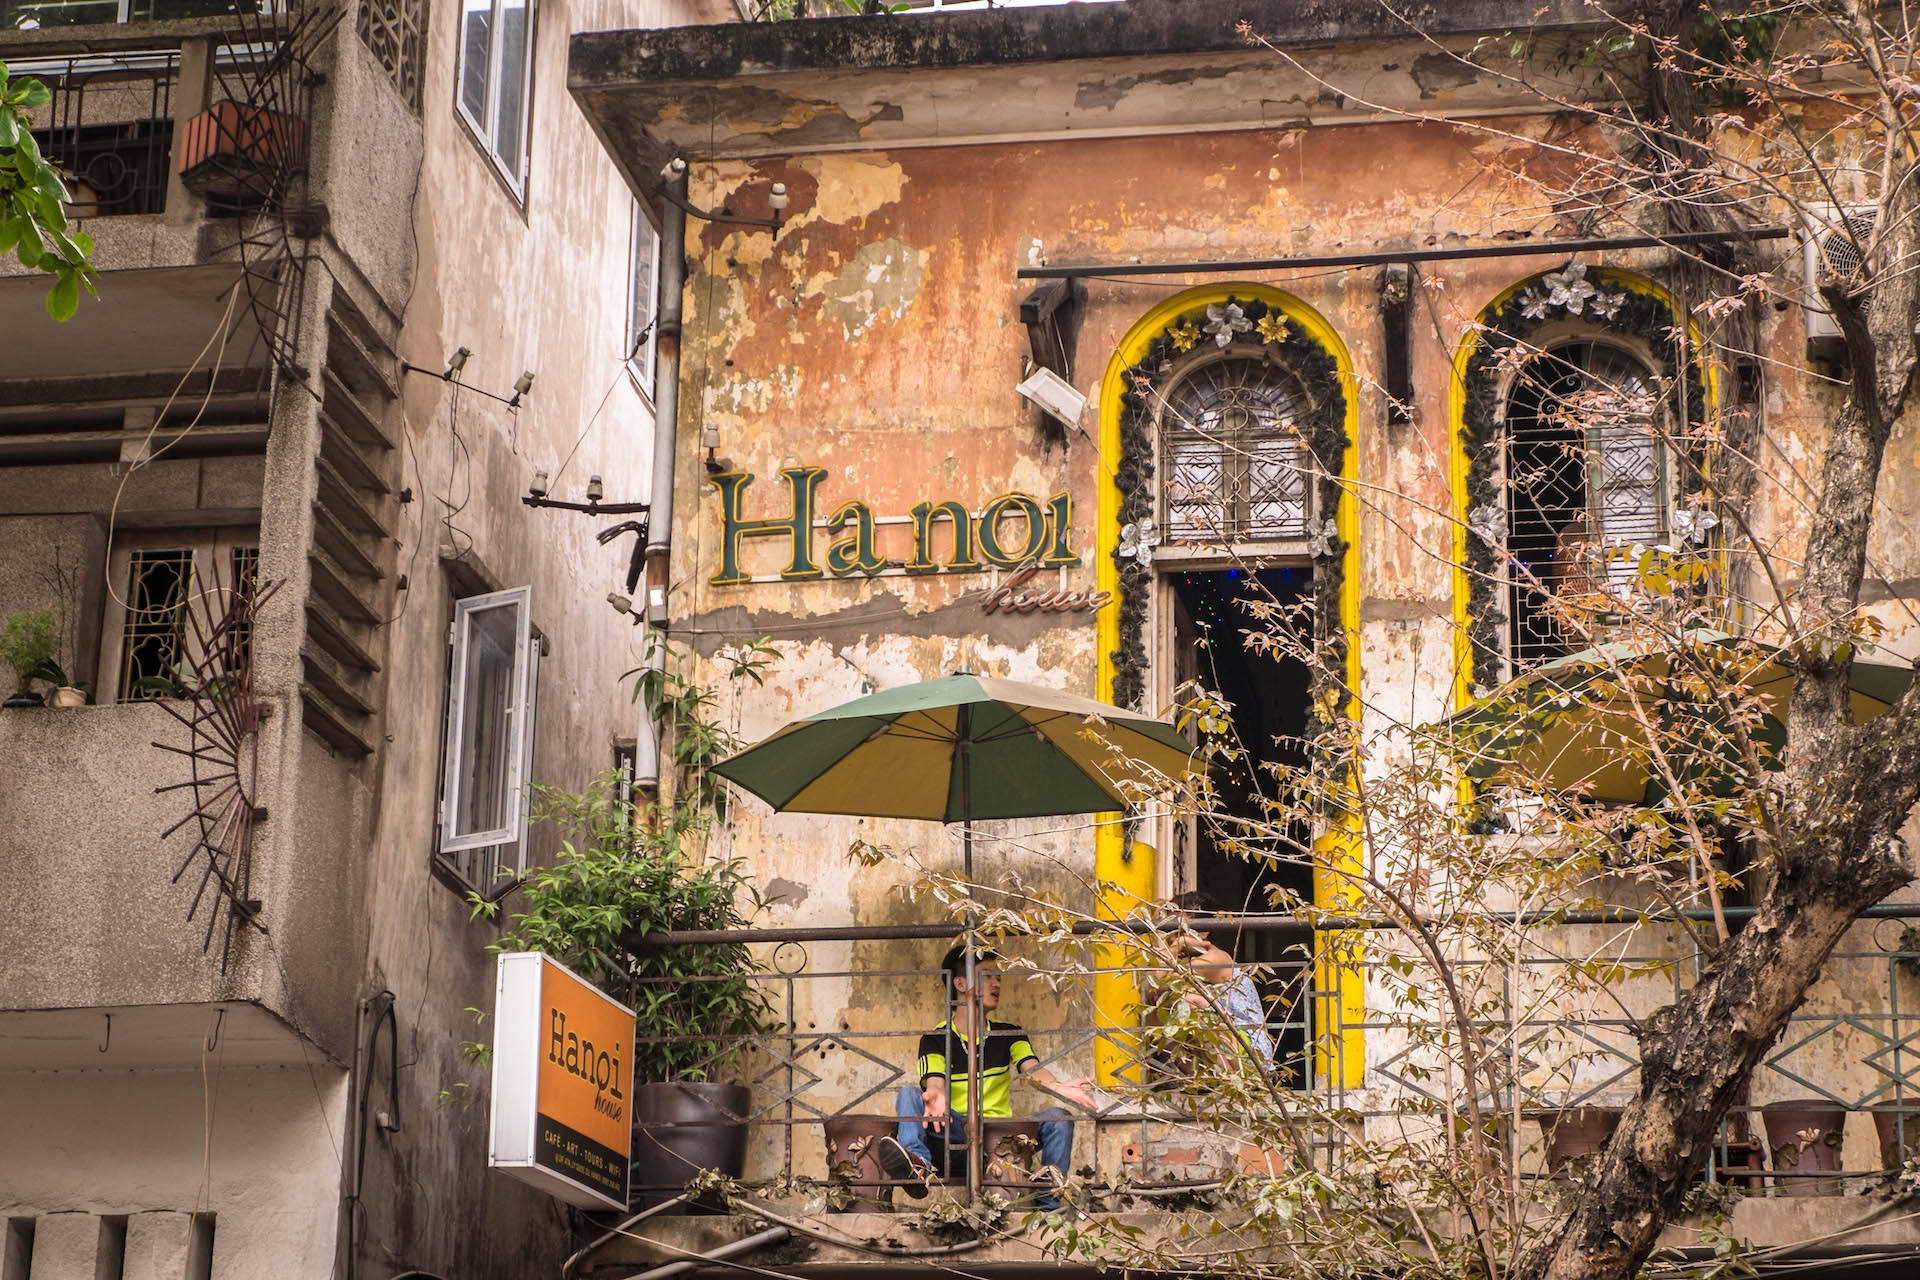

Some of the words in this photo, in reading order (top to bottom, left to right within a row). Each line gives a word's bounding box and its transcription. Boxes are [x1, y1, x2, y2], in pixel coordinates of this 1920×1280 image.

[709, 465, 1082, 585] Hanoi
[979, 556, 1114, 615] house
[549, 1007, 622, 1100] Hanoi
[594, 1087, 622, 1122] house
[566, 1141, 579, 1156] ART
[584, 1149, 604, 1169] TOURS
